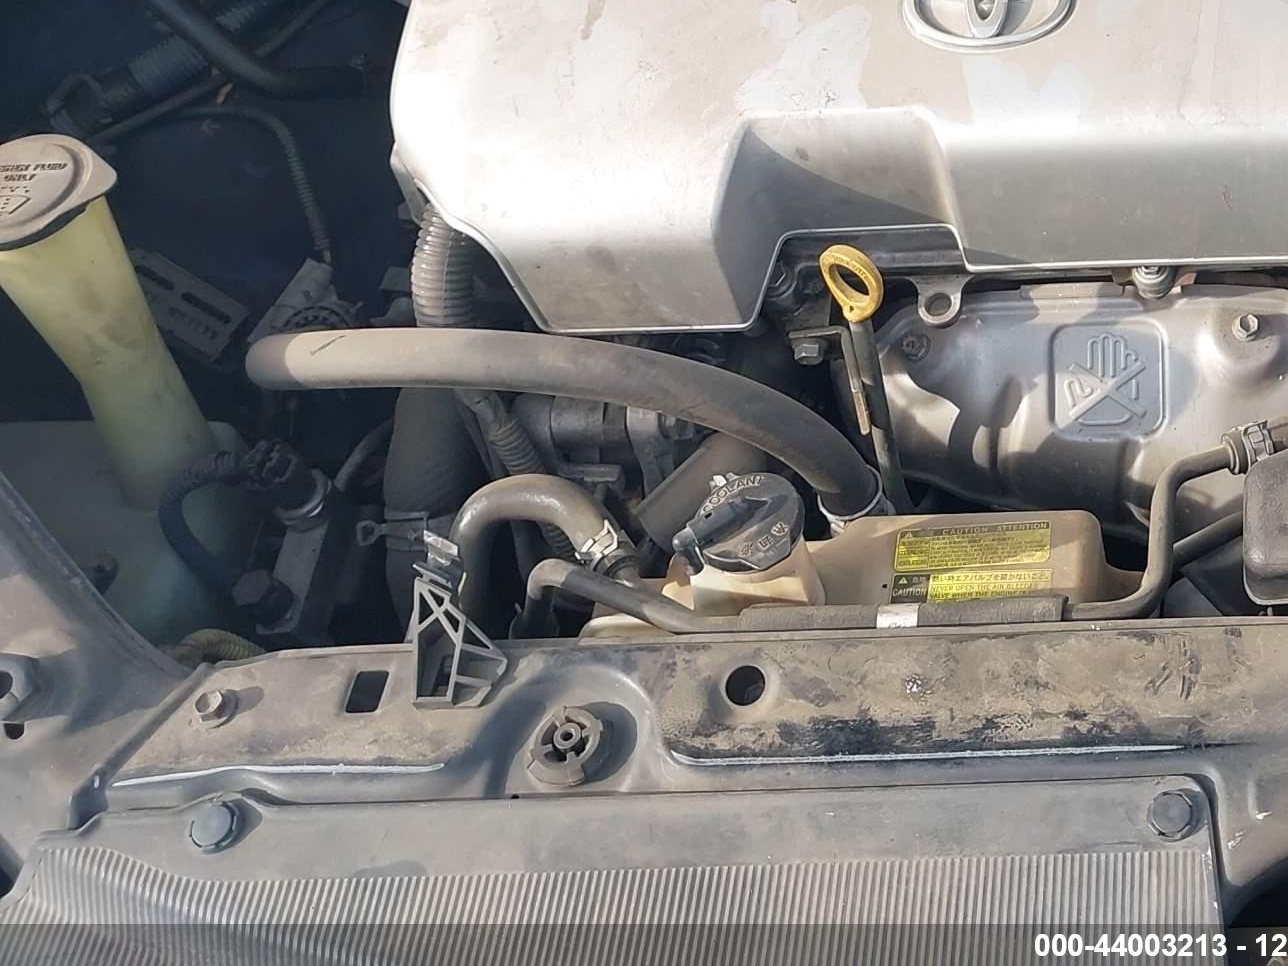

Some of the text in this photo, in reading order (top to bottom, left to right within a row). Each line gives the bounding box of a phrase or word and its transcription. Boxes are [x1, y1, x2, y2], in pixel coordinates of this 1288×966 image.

[702, 475, 765, 515] COOLANT
[942, 522, 1048, 536] CAUTION ATTENTION
[892, 587, 928, 598] CAUTION
[930, 584, 954, 592] NEVER
